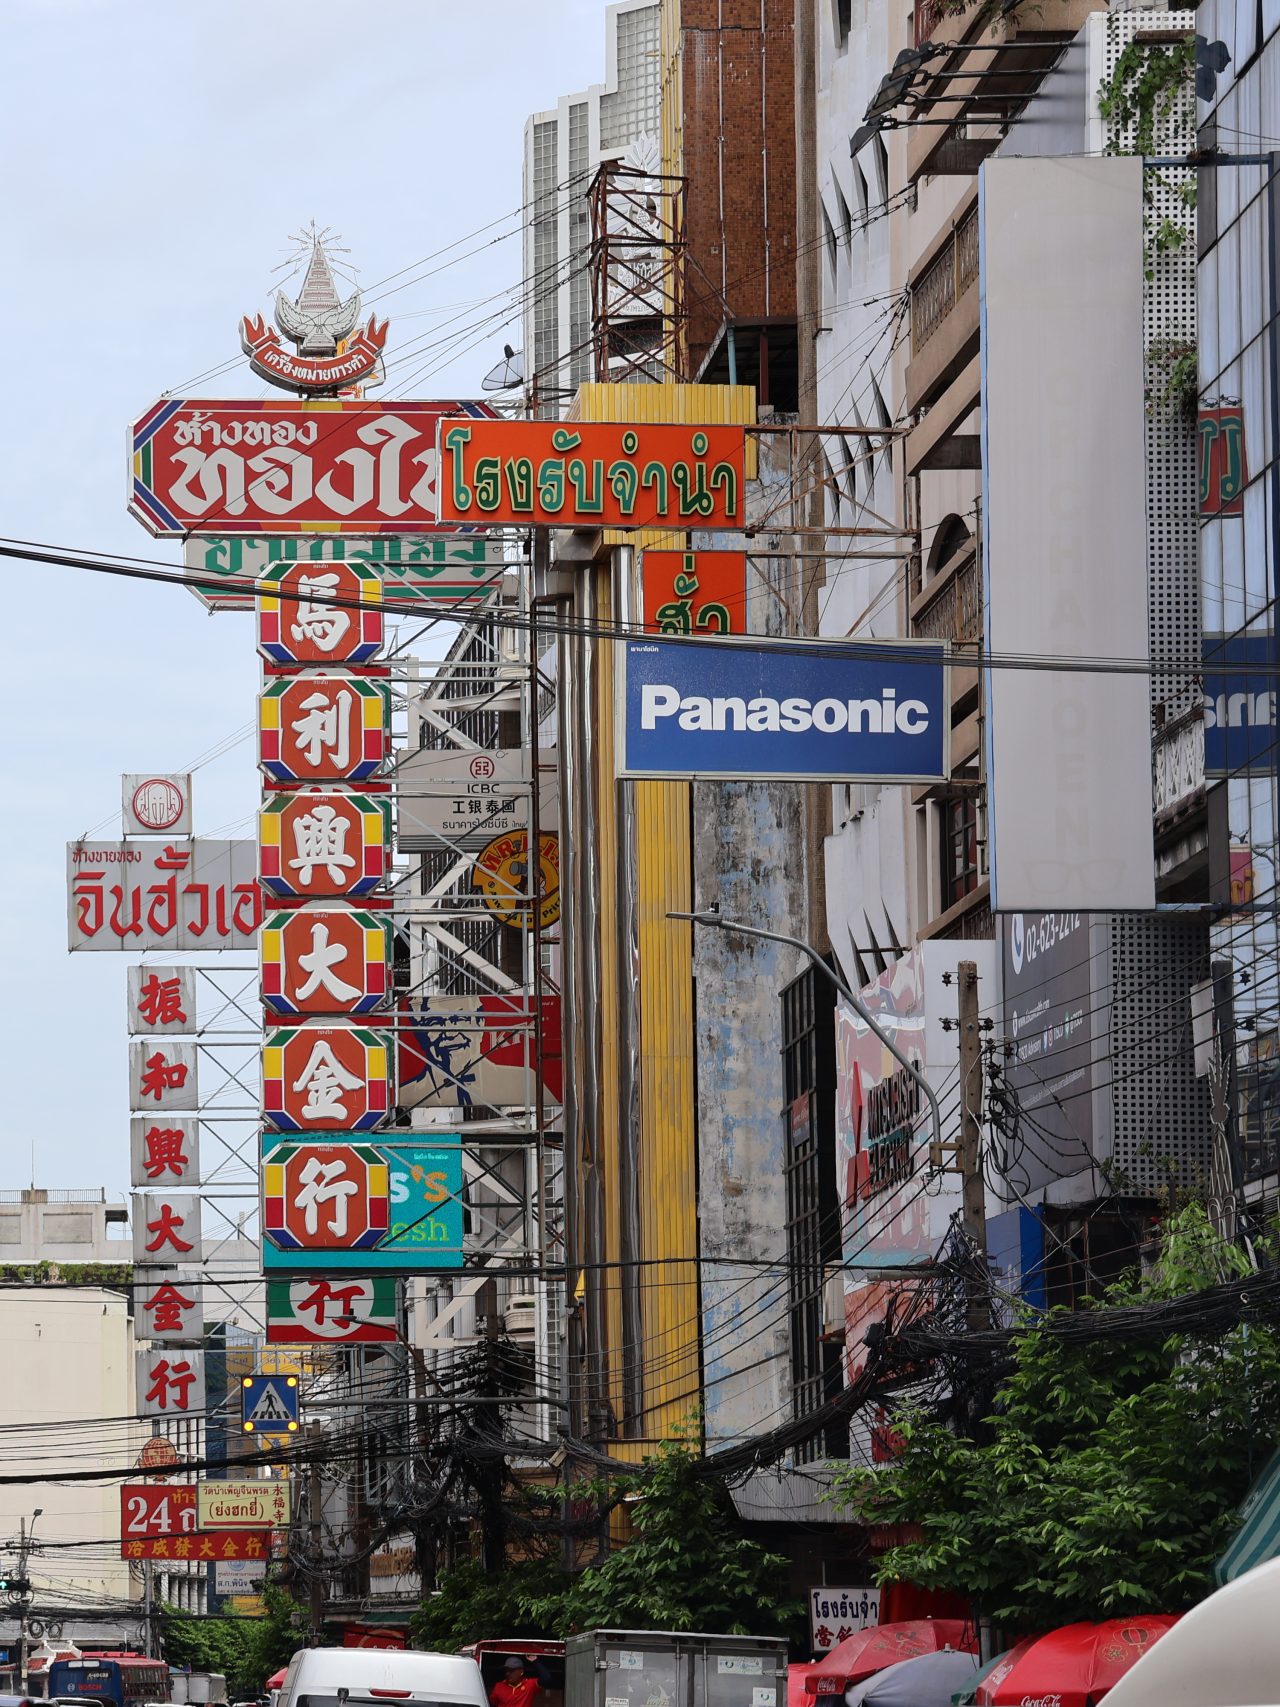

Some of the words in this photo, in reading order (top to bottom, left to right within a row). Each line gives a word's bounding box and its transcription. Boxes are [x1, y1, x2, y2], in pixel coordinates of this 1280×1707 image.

[263, 349, 368, 382] เครื่องหมายการค้า
[173, 411, 318, 447] ห้างทอง
[445, 426, 737, 518] โรงรับจำนำ
[290, 573, 351, 652] 馬
[291, 689, 352, 770] 利
[641, 684, 930, 735] Panasonic
[467, 783, 500, 794] ICBC
[72, 848, 142, 864] ห้างขายทอง
[288, 805, 357, 886] 興
[295, 922, 363, 1003] 大
[138, 974, 188, 1025] 振
[140, 1052, 188, 1101] 和
[293, 1041, 366, 1121] 金
[867, 1059, 920, 1141] MITSUBISHI
[142, 1126, 189, 1178] 興
[294, 1156, 359, 1238] 行
[145, 1203, 194, 1252] 大
[143, 1280, 196, 1332] 金
[145, 1359, 197, 1410] 行
[127, 1496, 173, 1533] 24
[203, 1484, 269, 1497] วัดบำเพ็ญจีนพรต
[813, 1591, 878, 1619] โรงรับจำ
